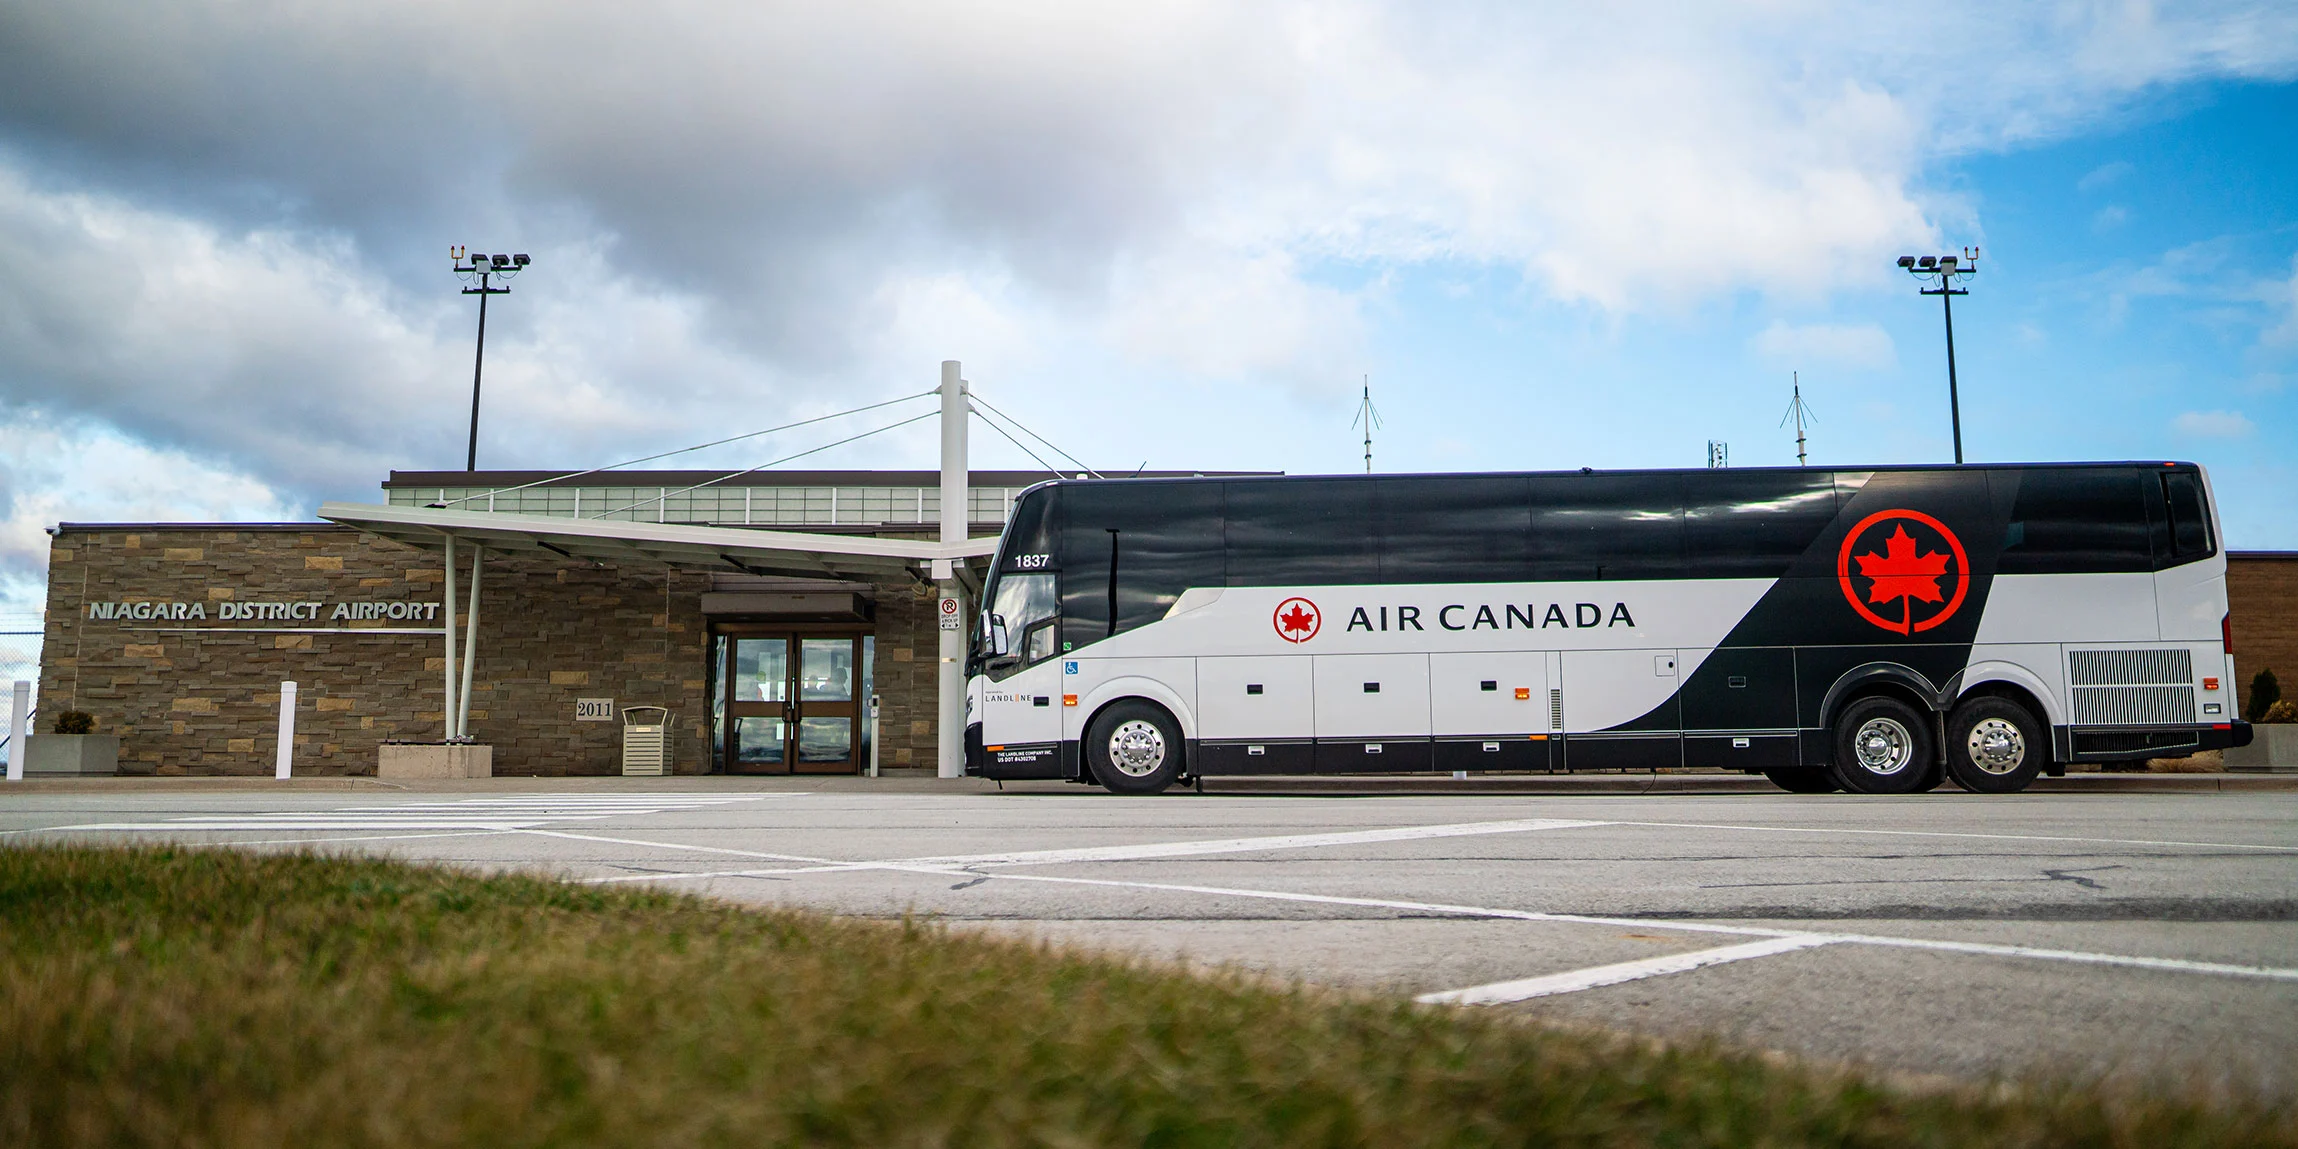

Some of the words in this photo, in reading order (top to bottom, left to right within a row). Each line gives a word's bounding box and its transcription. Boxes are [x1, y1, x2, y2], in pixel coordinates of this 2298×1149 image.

[1015, 554, 1050, 568] 1837
[89, 602, 207, 620] NIAGARA
[218, 602, 323, 620] DISTRICT
[330, 602, 440, 620] AIRPORT
[1346, 606, 1425, 632] AIR
[1438, 602, 1636, 632] CANADA
[578, 702, 612, 717] 2011
